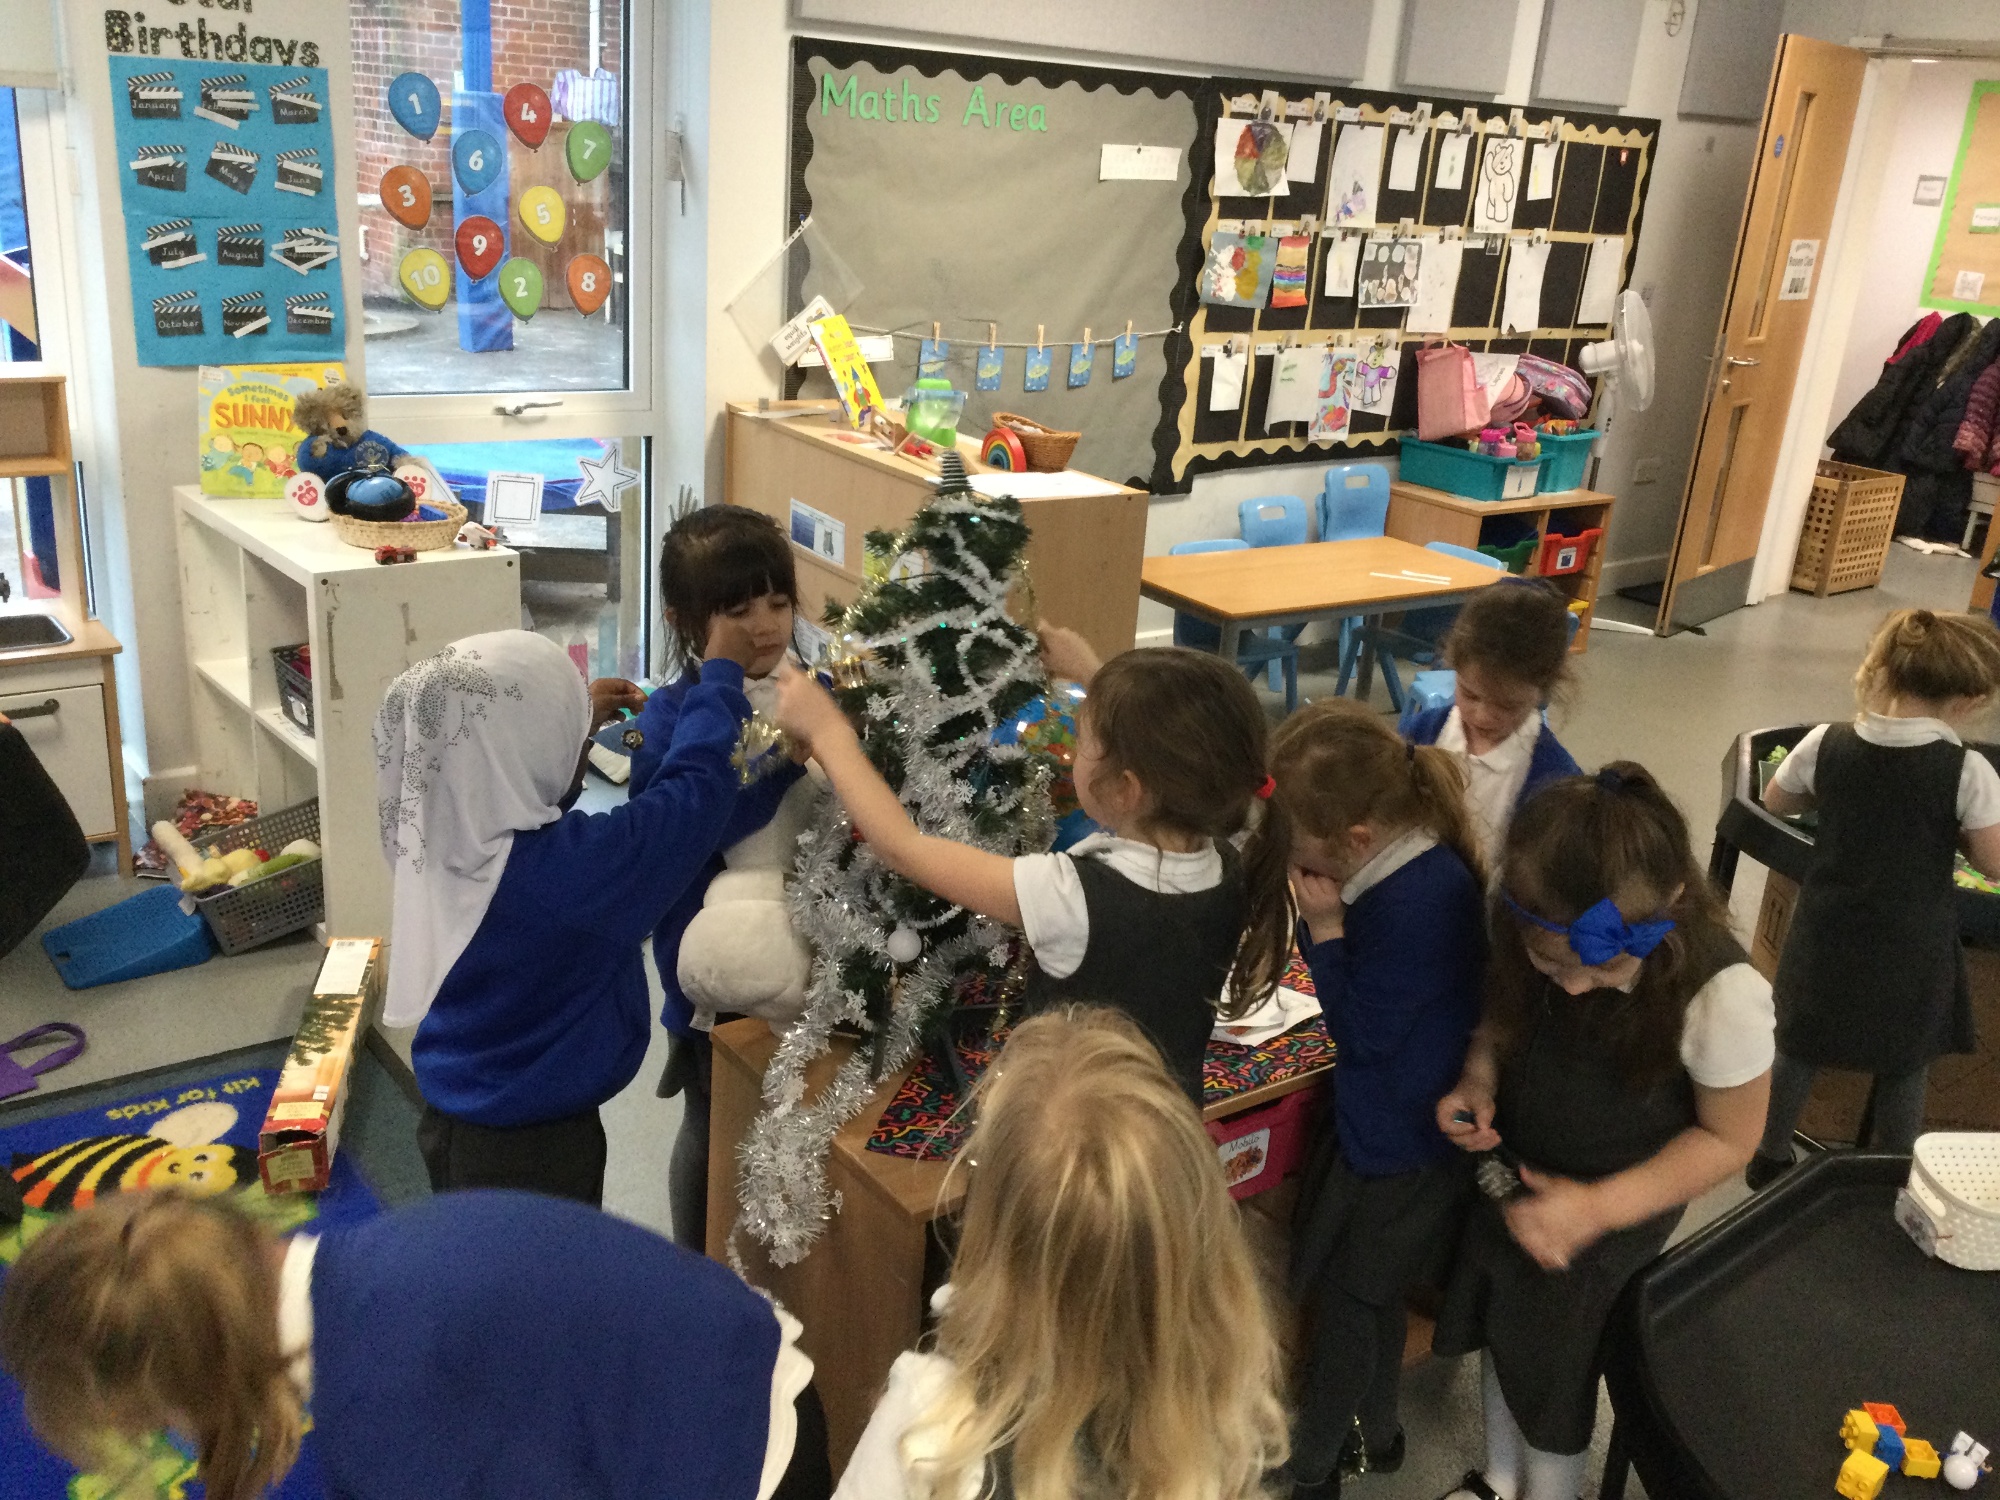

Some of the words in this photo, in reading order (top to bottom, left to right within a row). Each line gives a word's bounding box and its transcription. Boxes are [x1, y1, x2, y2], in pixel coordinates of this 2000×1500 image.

[105, 10, 319, 67] Birthdays
[132, 99, 177, 112] January
[280, 108, 310, 117] March
[408, 93, 422, 115] 1
[521, 102, 538, 124] 4
[821, 73, 941, 123] Maths
[962, 86, 1048, 132] Area
[583, 138, 597, 160] 7
[468, 149, 484, 171] 6
[147, 170, 175, 182] April
[219, 165, 239, 184] May
[287, 174, 310, 184] June
[398, 184, 416, 207] 3
[536, 204, 551, 225] 5
[161, 247, 185, 257] July
[222, 249, 258, 260] August
[472, 234, 488, 257] 9
[410, 265, 441, 291] 10
[514, 277, 528, 298] 2
[581, 272, 596, 292] 8
[158, 319, 199, 329] October
[287, 316, 329, 325] December
[227, 384, 289, 402] Sometimes
[214, 402, 295, 433] SUNNY
